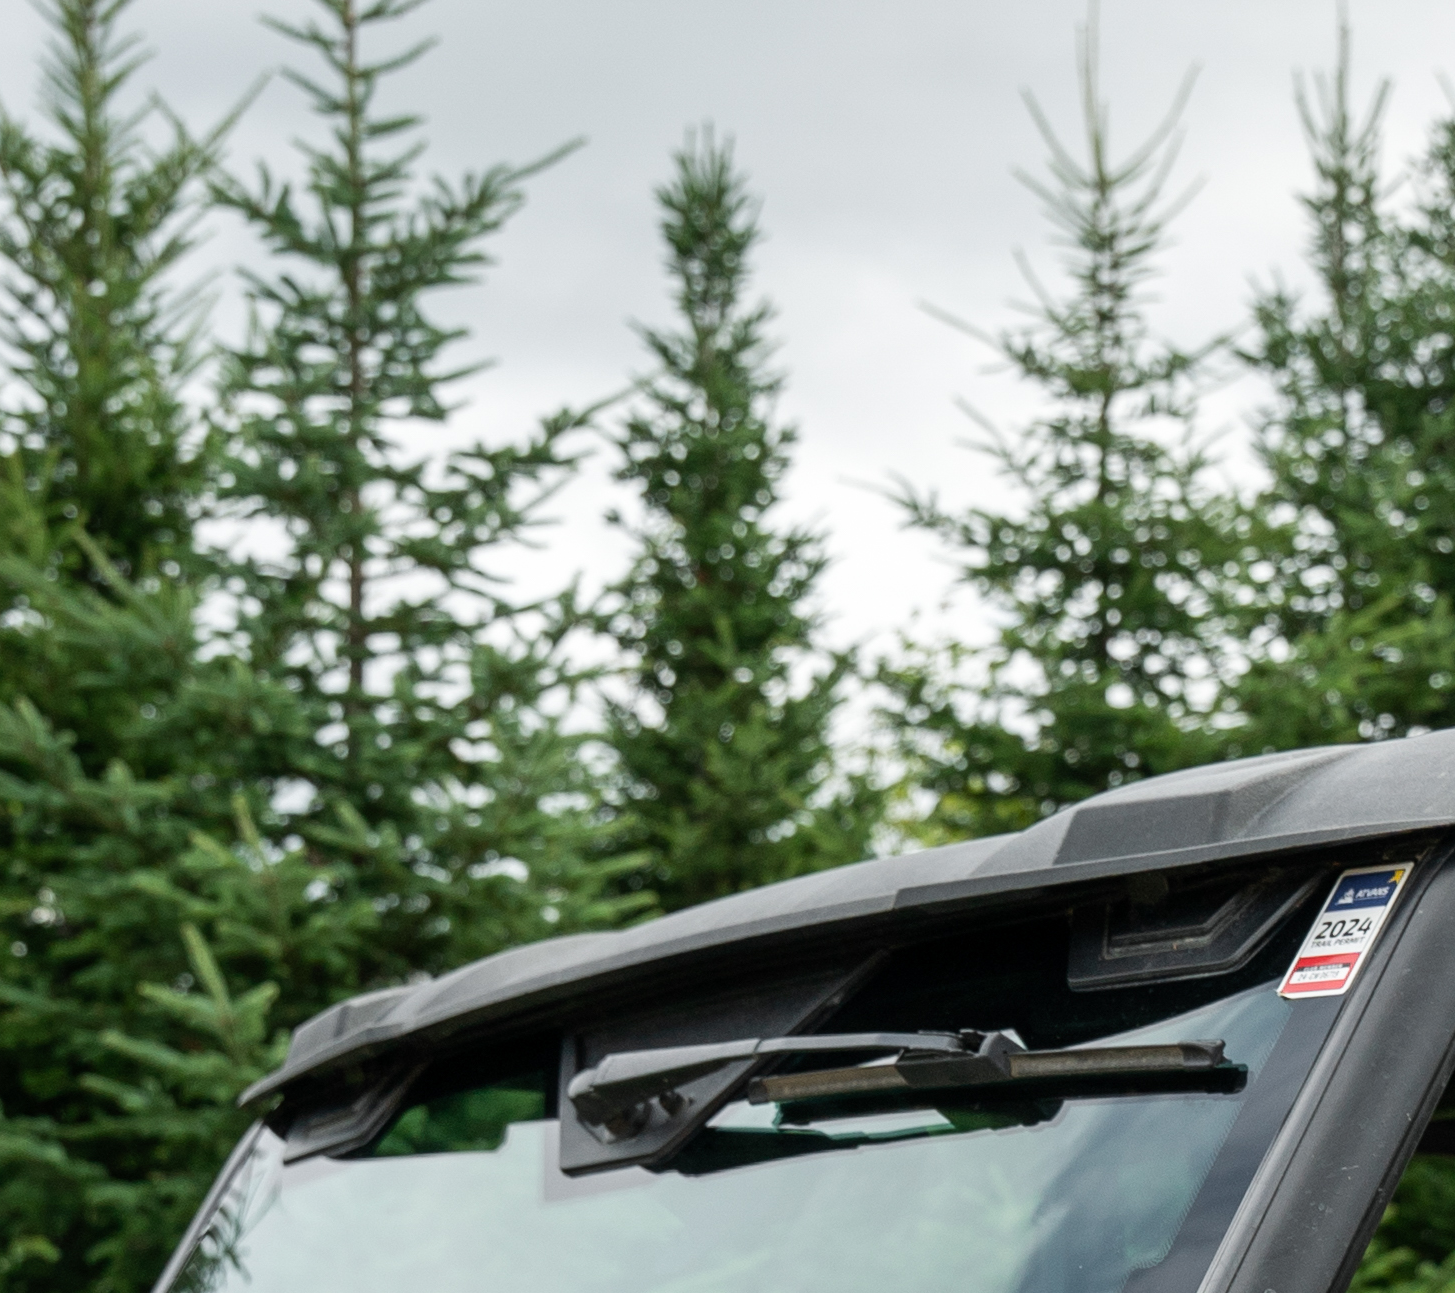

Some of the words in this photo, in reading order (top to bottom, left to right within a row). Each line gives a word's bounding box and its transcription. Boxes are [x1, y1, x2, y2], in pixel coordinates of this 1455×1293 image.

[1314, 917, 1373, 941] 2024
[1311, 939, 1332, 949] TRAIL
[1333, 936, 1366, 946] PERMIT
